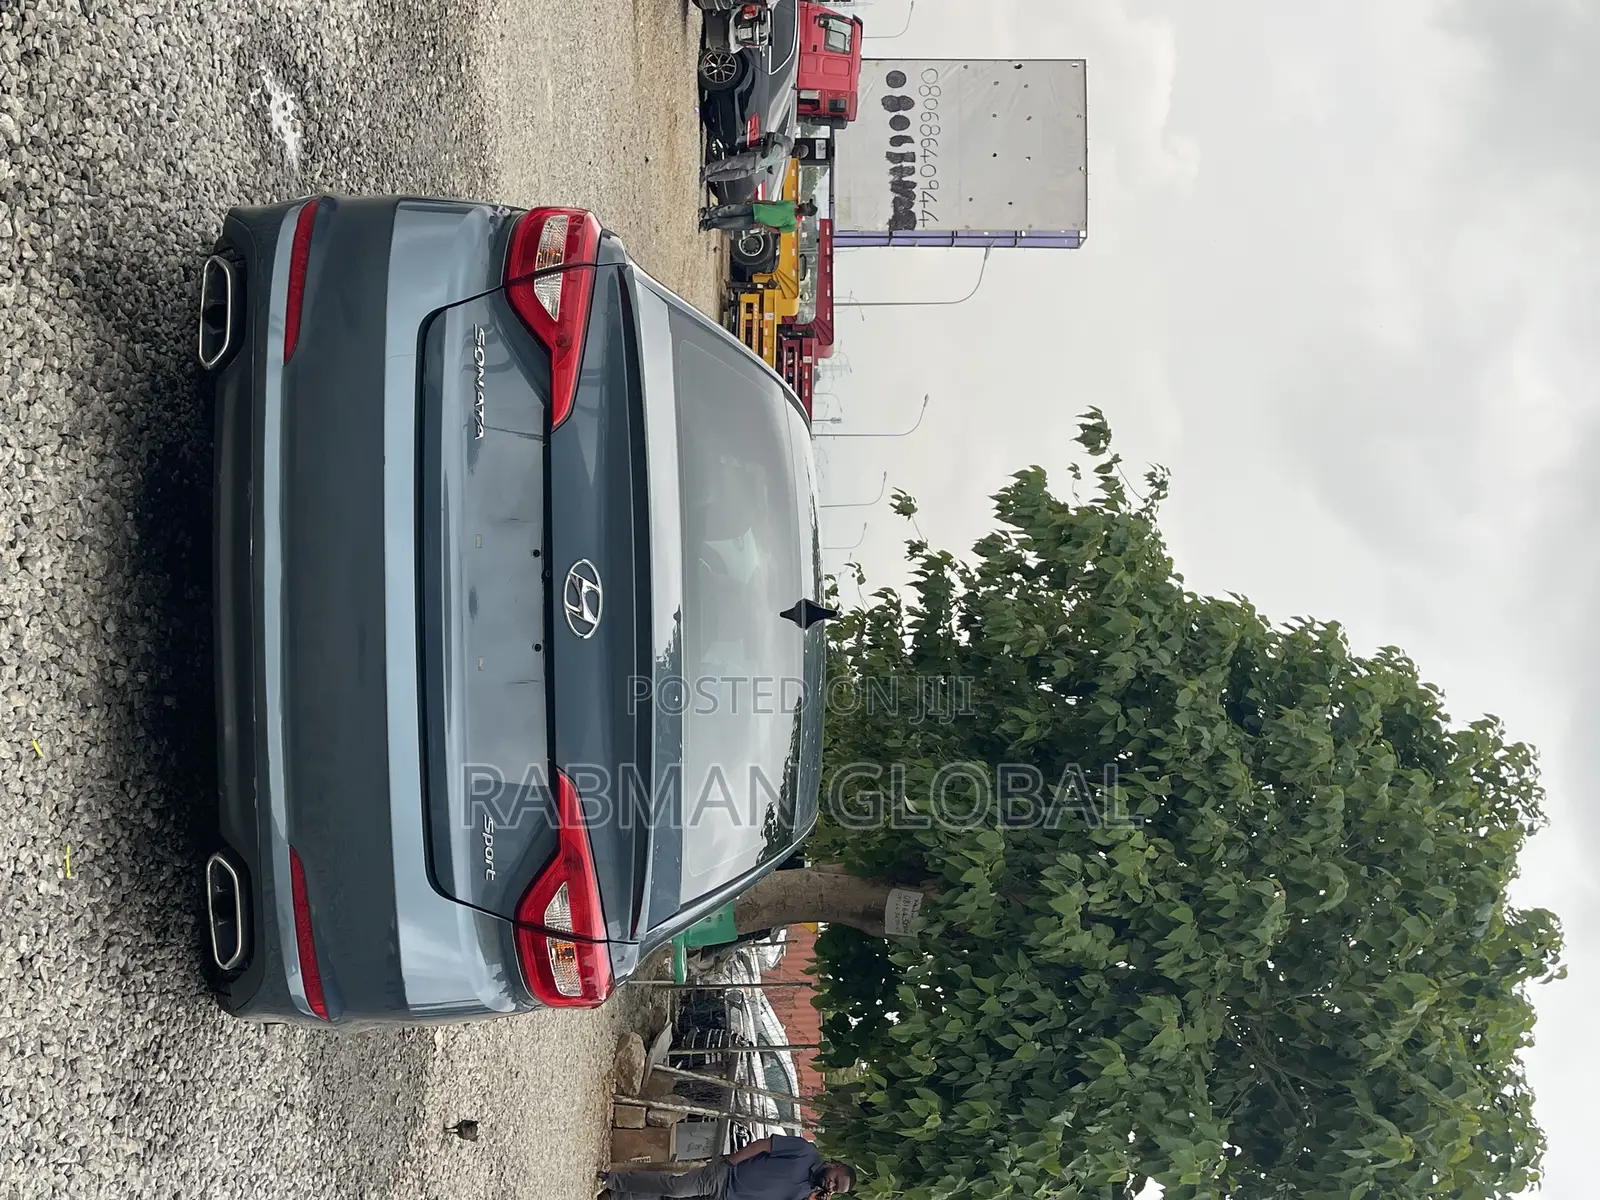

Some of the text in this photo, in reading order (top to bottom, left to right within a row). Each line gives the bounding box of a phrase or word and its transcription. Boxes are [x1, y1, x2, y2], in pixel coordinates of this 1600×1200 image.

[918, 68, 943, 228] 08068640944
[473, 323, 486, 440] SONATA
[481, 814, 496, 881] Sport
